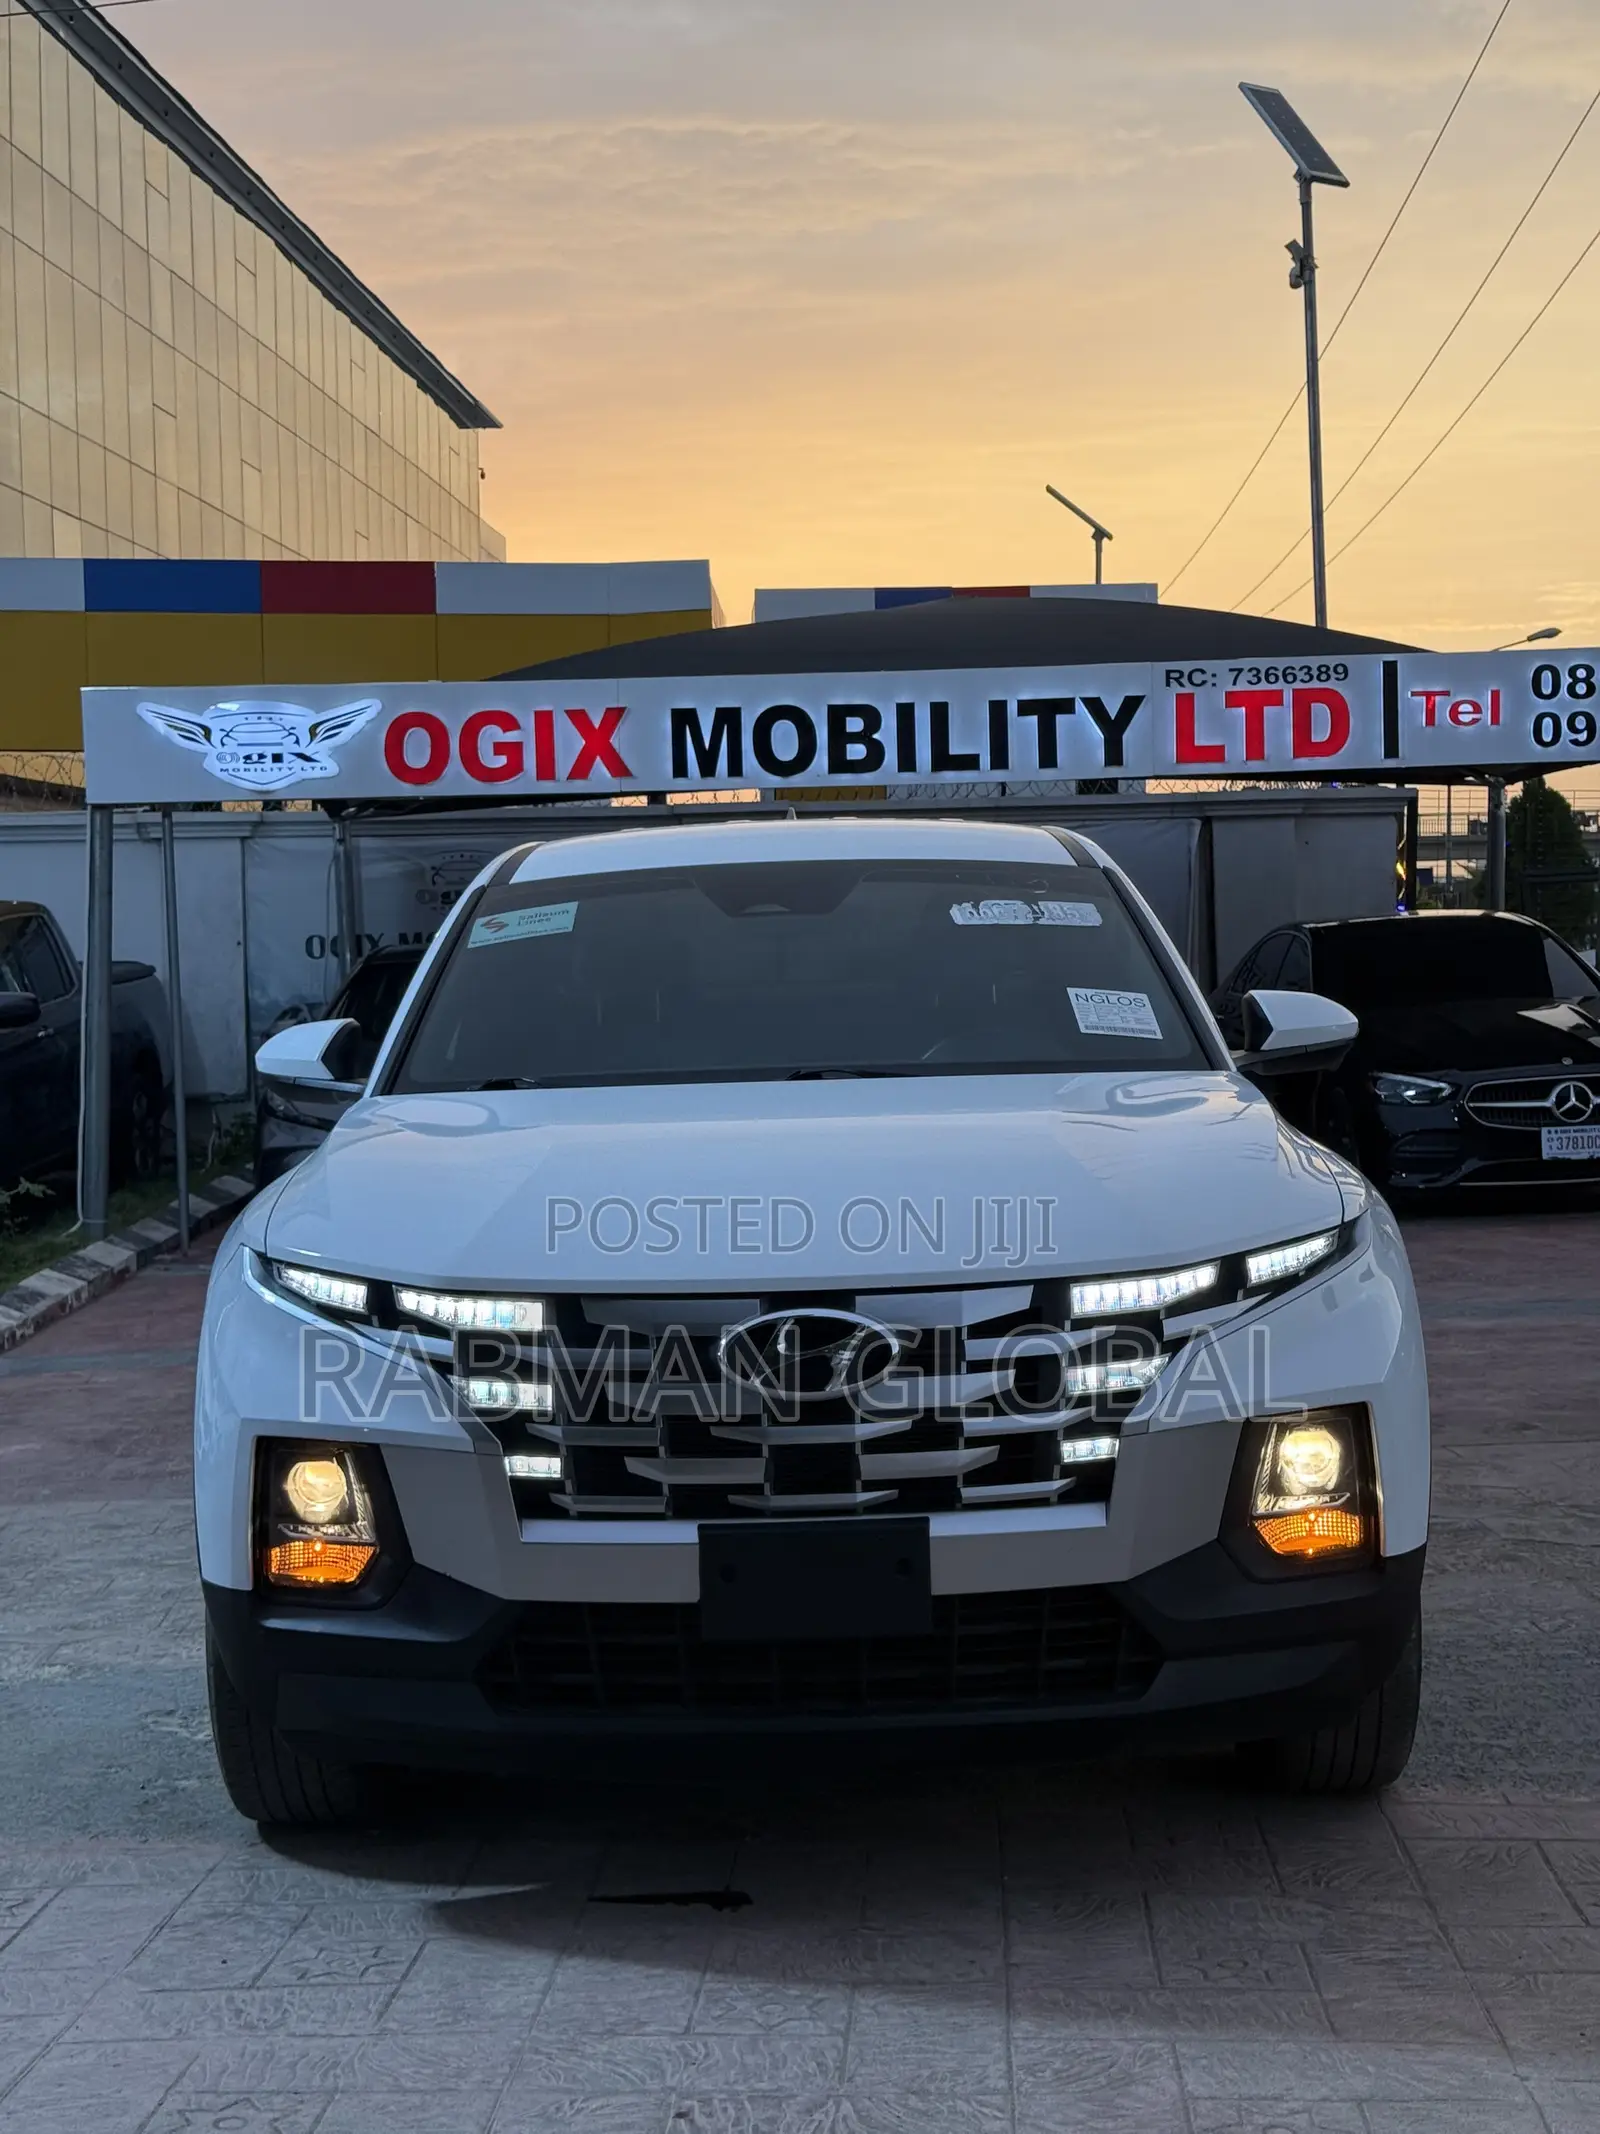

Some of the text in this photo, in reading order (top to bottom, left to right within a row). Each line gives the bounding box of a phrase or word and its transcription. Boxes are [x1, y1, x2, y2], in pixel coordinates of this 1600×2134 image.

[1165, 663, 1349, 688] RC: 7366389
[1531, 663, 1597, 701] 08
[384, 687, 1501, 785] OGIX MOBILITY LTD Tel
[1532, 710, 1597, 748] 09
[1074, 993, 1146, 1008] NGLOS
